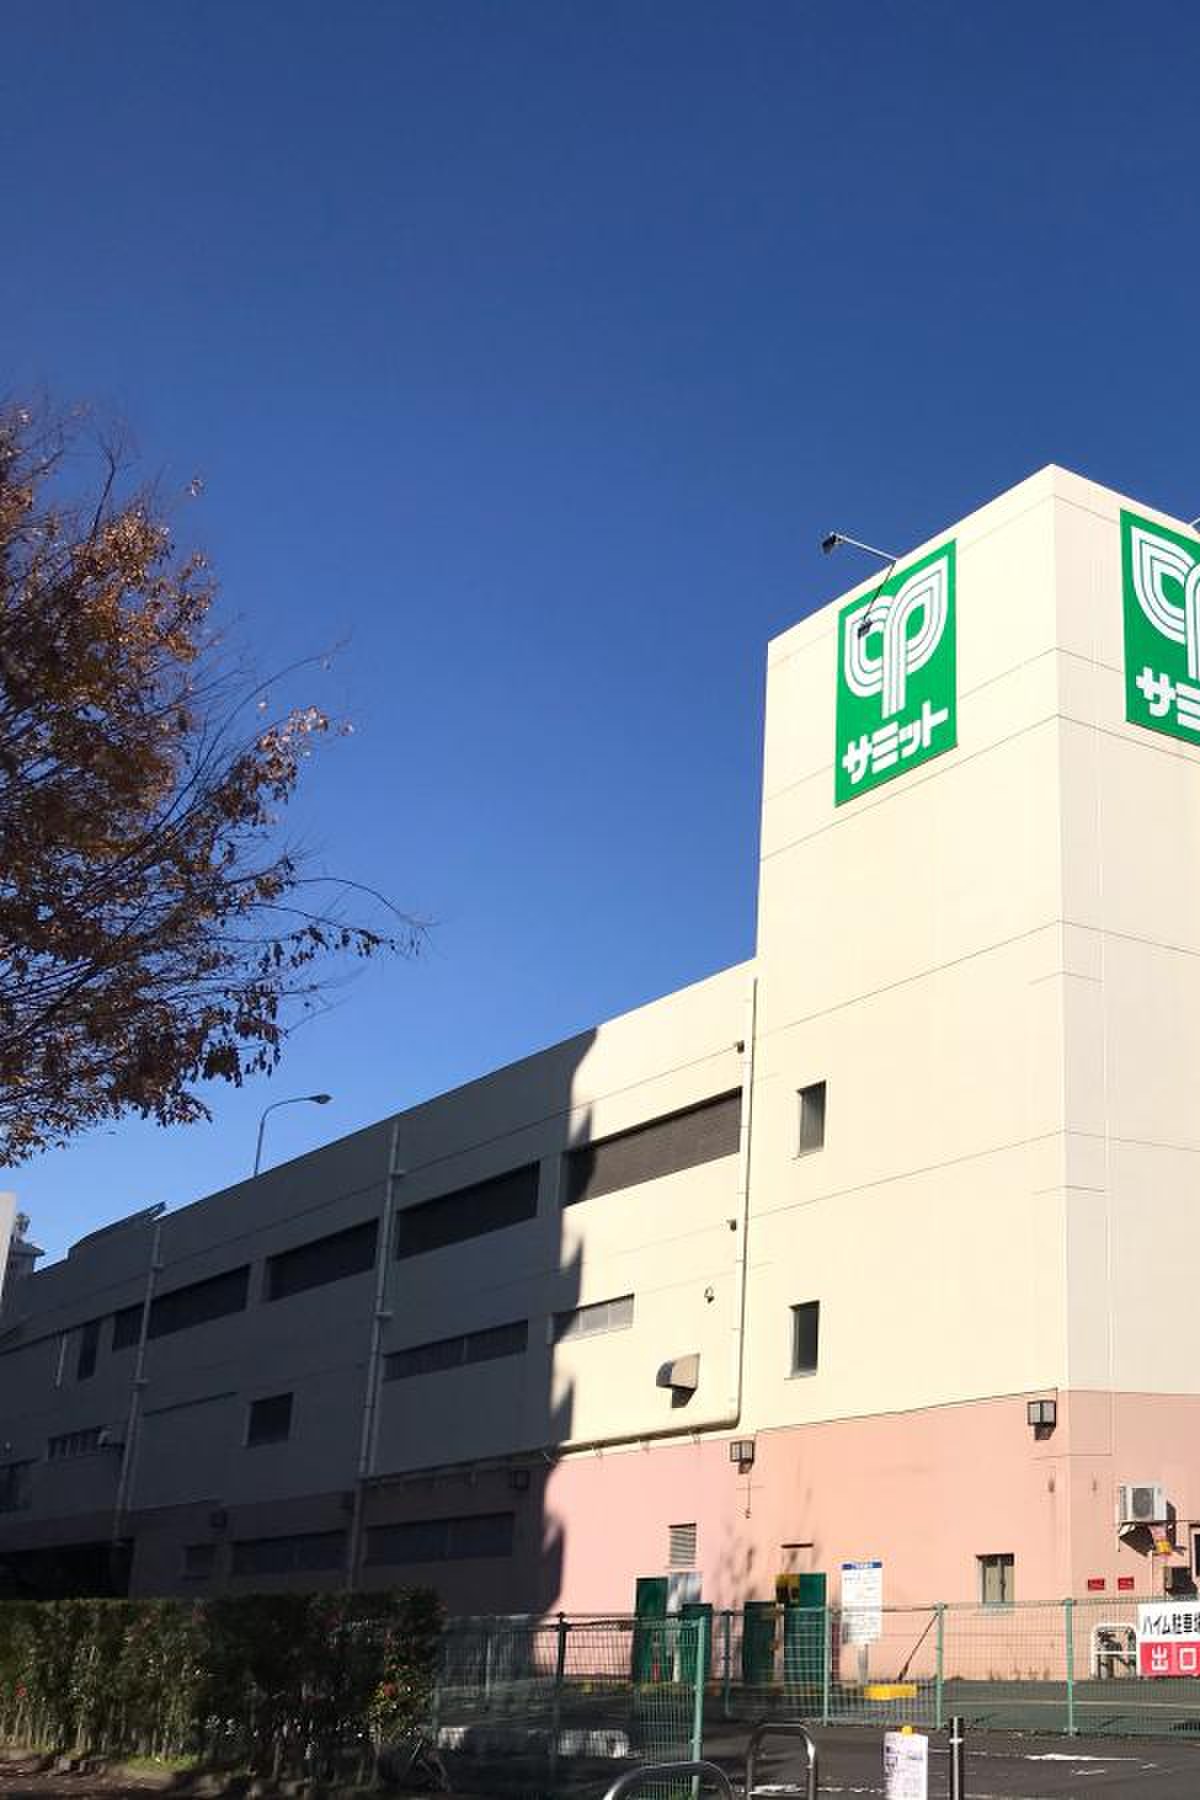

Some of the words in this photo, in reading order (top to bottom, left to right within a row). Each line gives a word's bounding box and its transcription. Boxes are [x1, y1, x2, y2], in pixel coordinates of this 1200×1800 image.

[842, 699, 949, 784] サミット
[1151, 1645, 1198, 1671] 出口
